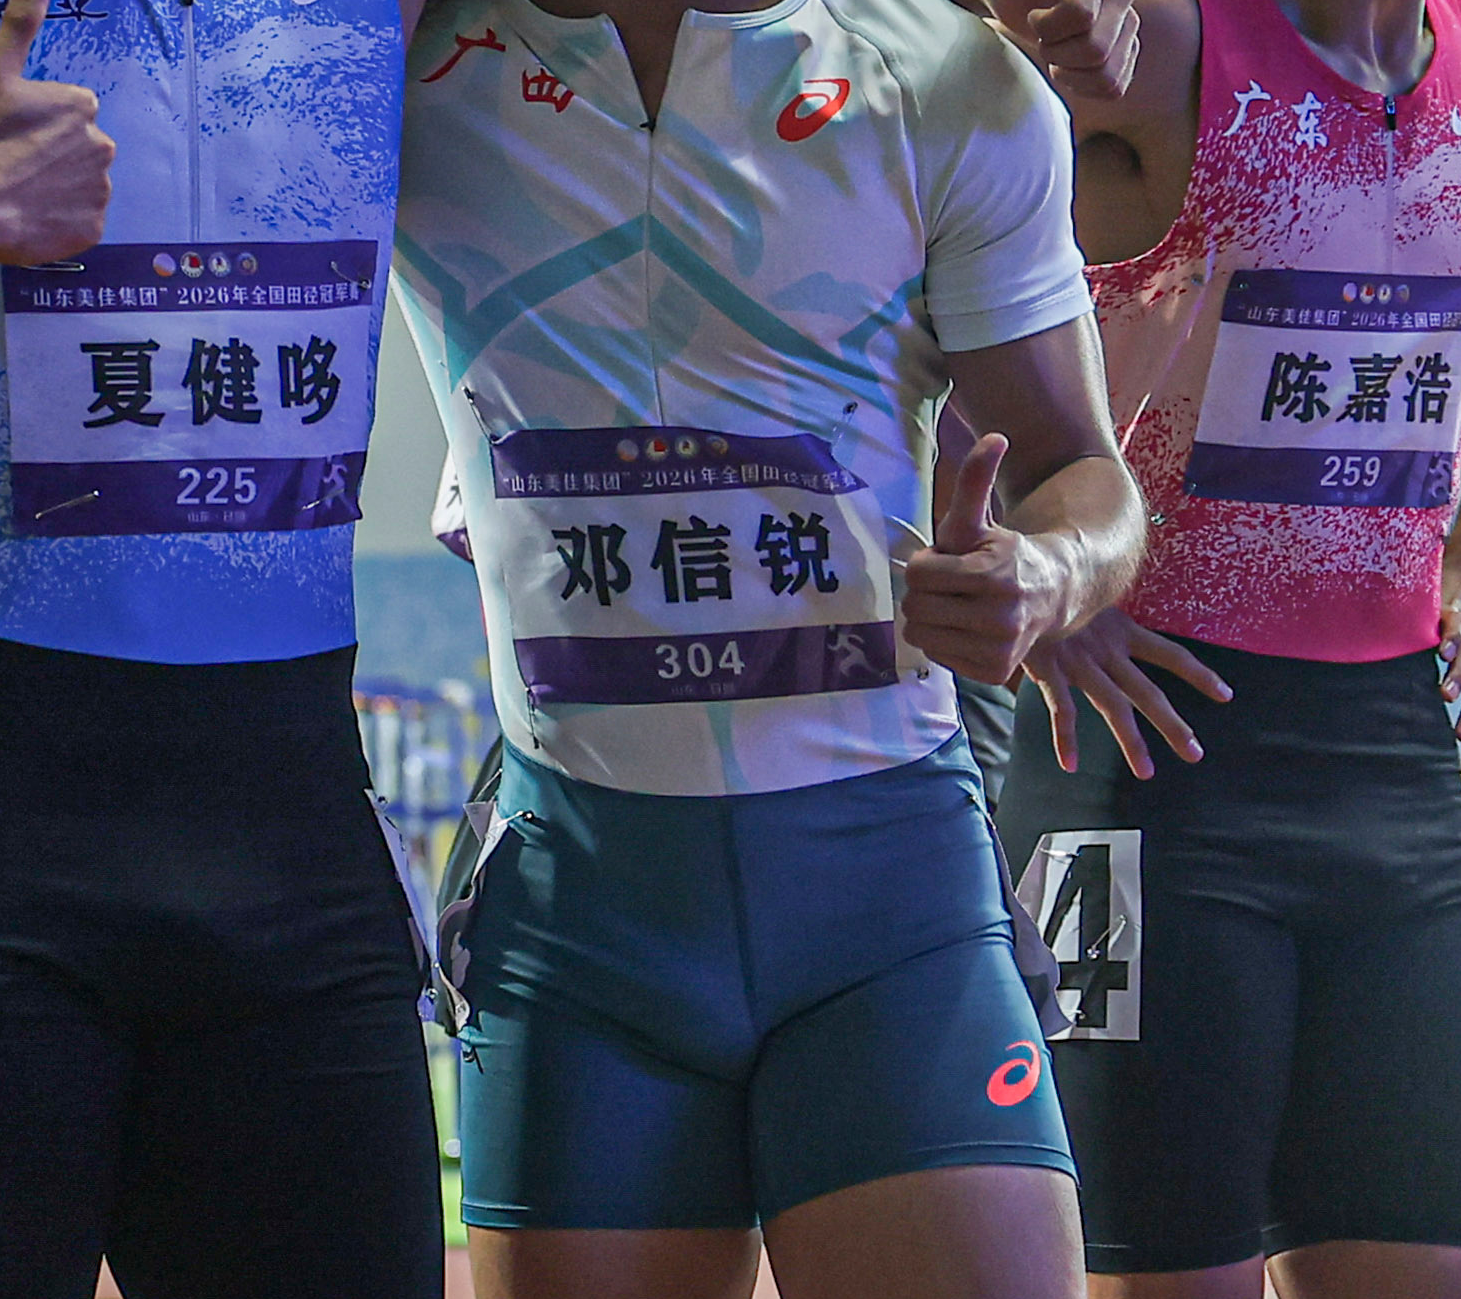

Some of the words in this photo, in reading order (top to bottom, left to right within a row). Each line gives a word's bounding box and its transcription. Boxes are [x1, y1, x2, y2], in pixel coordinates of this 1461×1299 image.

[419, 28, 574, 113] 广西
[1222, 79, 1330, 151] 广东
[80, 334, 341, 428] 夏健哆
[1261, 351, 1453, 424] 陈嘉浩
[176, 466, 257, 505] 225
[1320, 455, 1381, 487] 259
[551, 512, 839, 606] 邓信锐
[655, 640, 746, 679] 304
[1043, 843, 1128, 1029] 4
